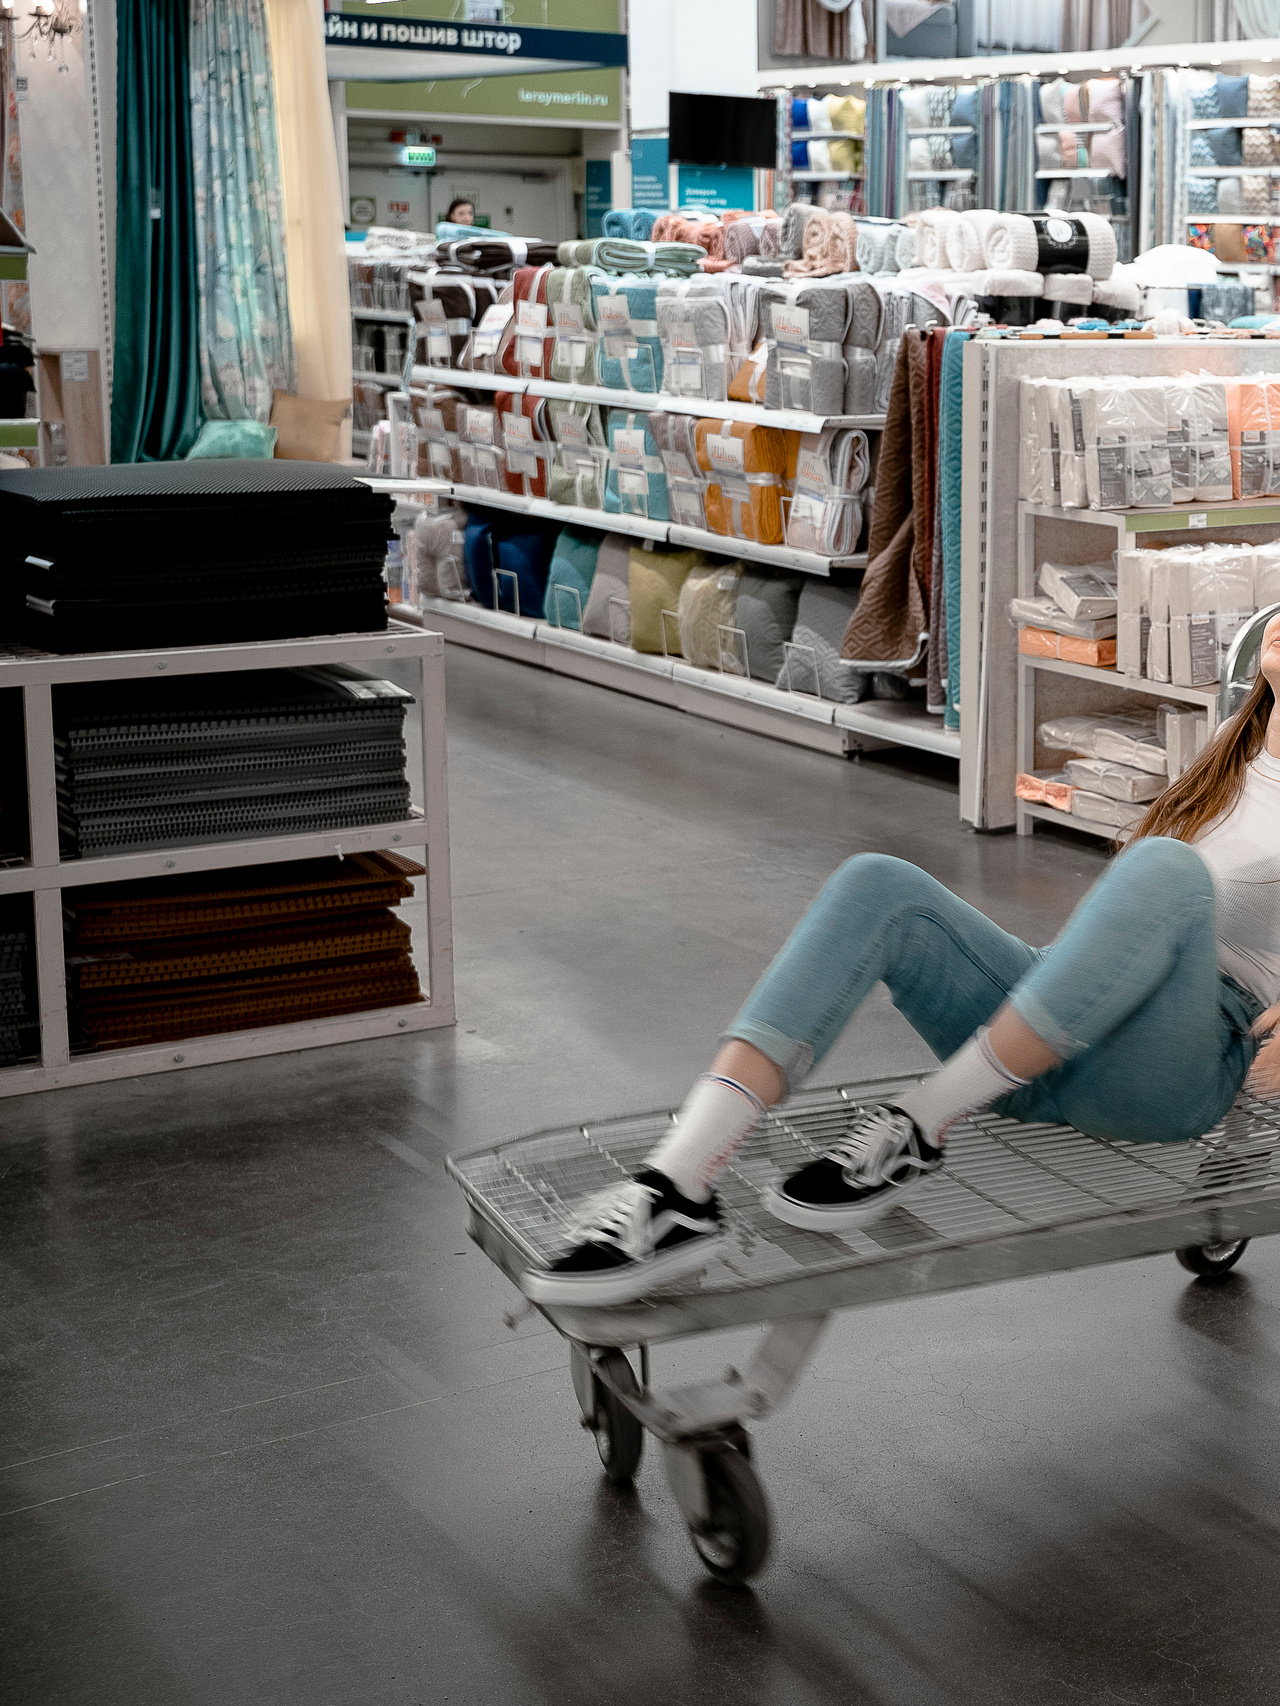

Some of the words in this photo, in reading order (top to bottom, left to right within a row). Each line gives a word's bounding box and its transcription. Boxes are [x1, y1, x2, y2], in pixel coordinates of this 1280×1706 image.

[361, 22, 378, 40] и
[380, 23, 458, 46] пошив
[461, 29, 522, 54] штор
[518, 87, 609, 106] leroymerlin.ru
